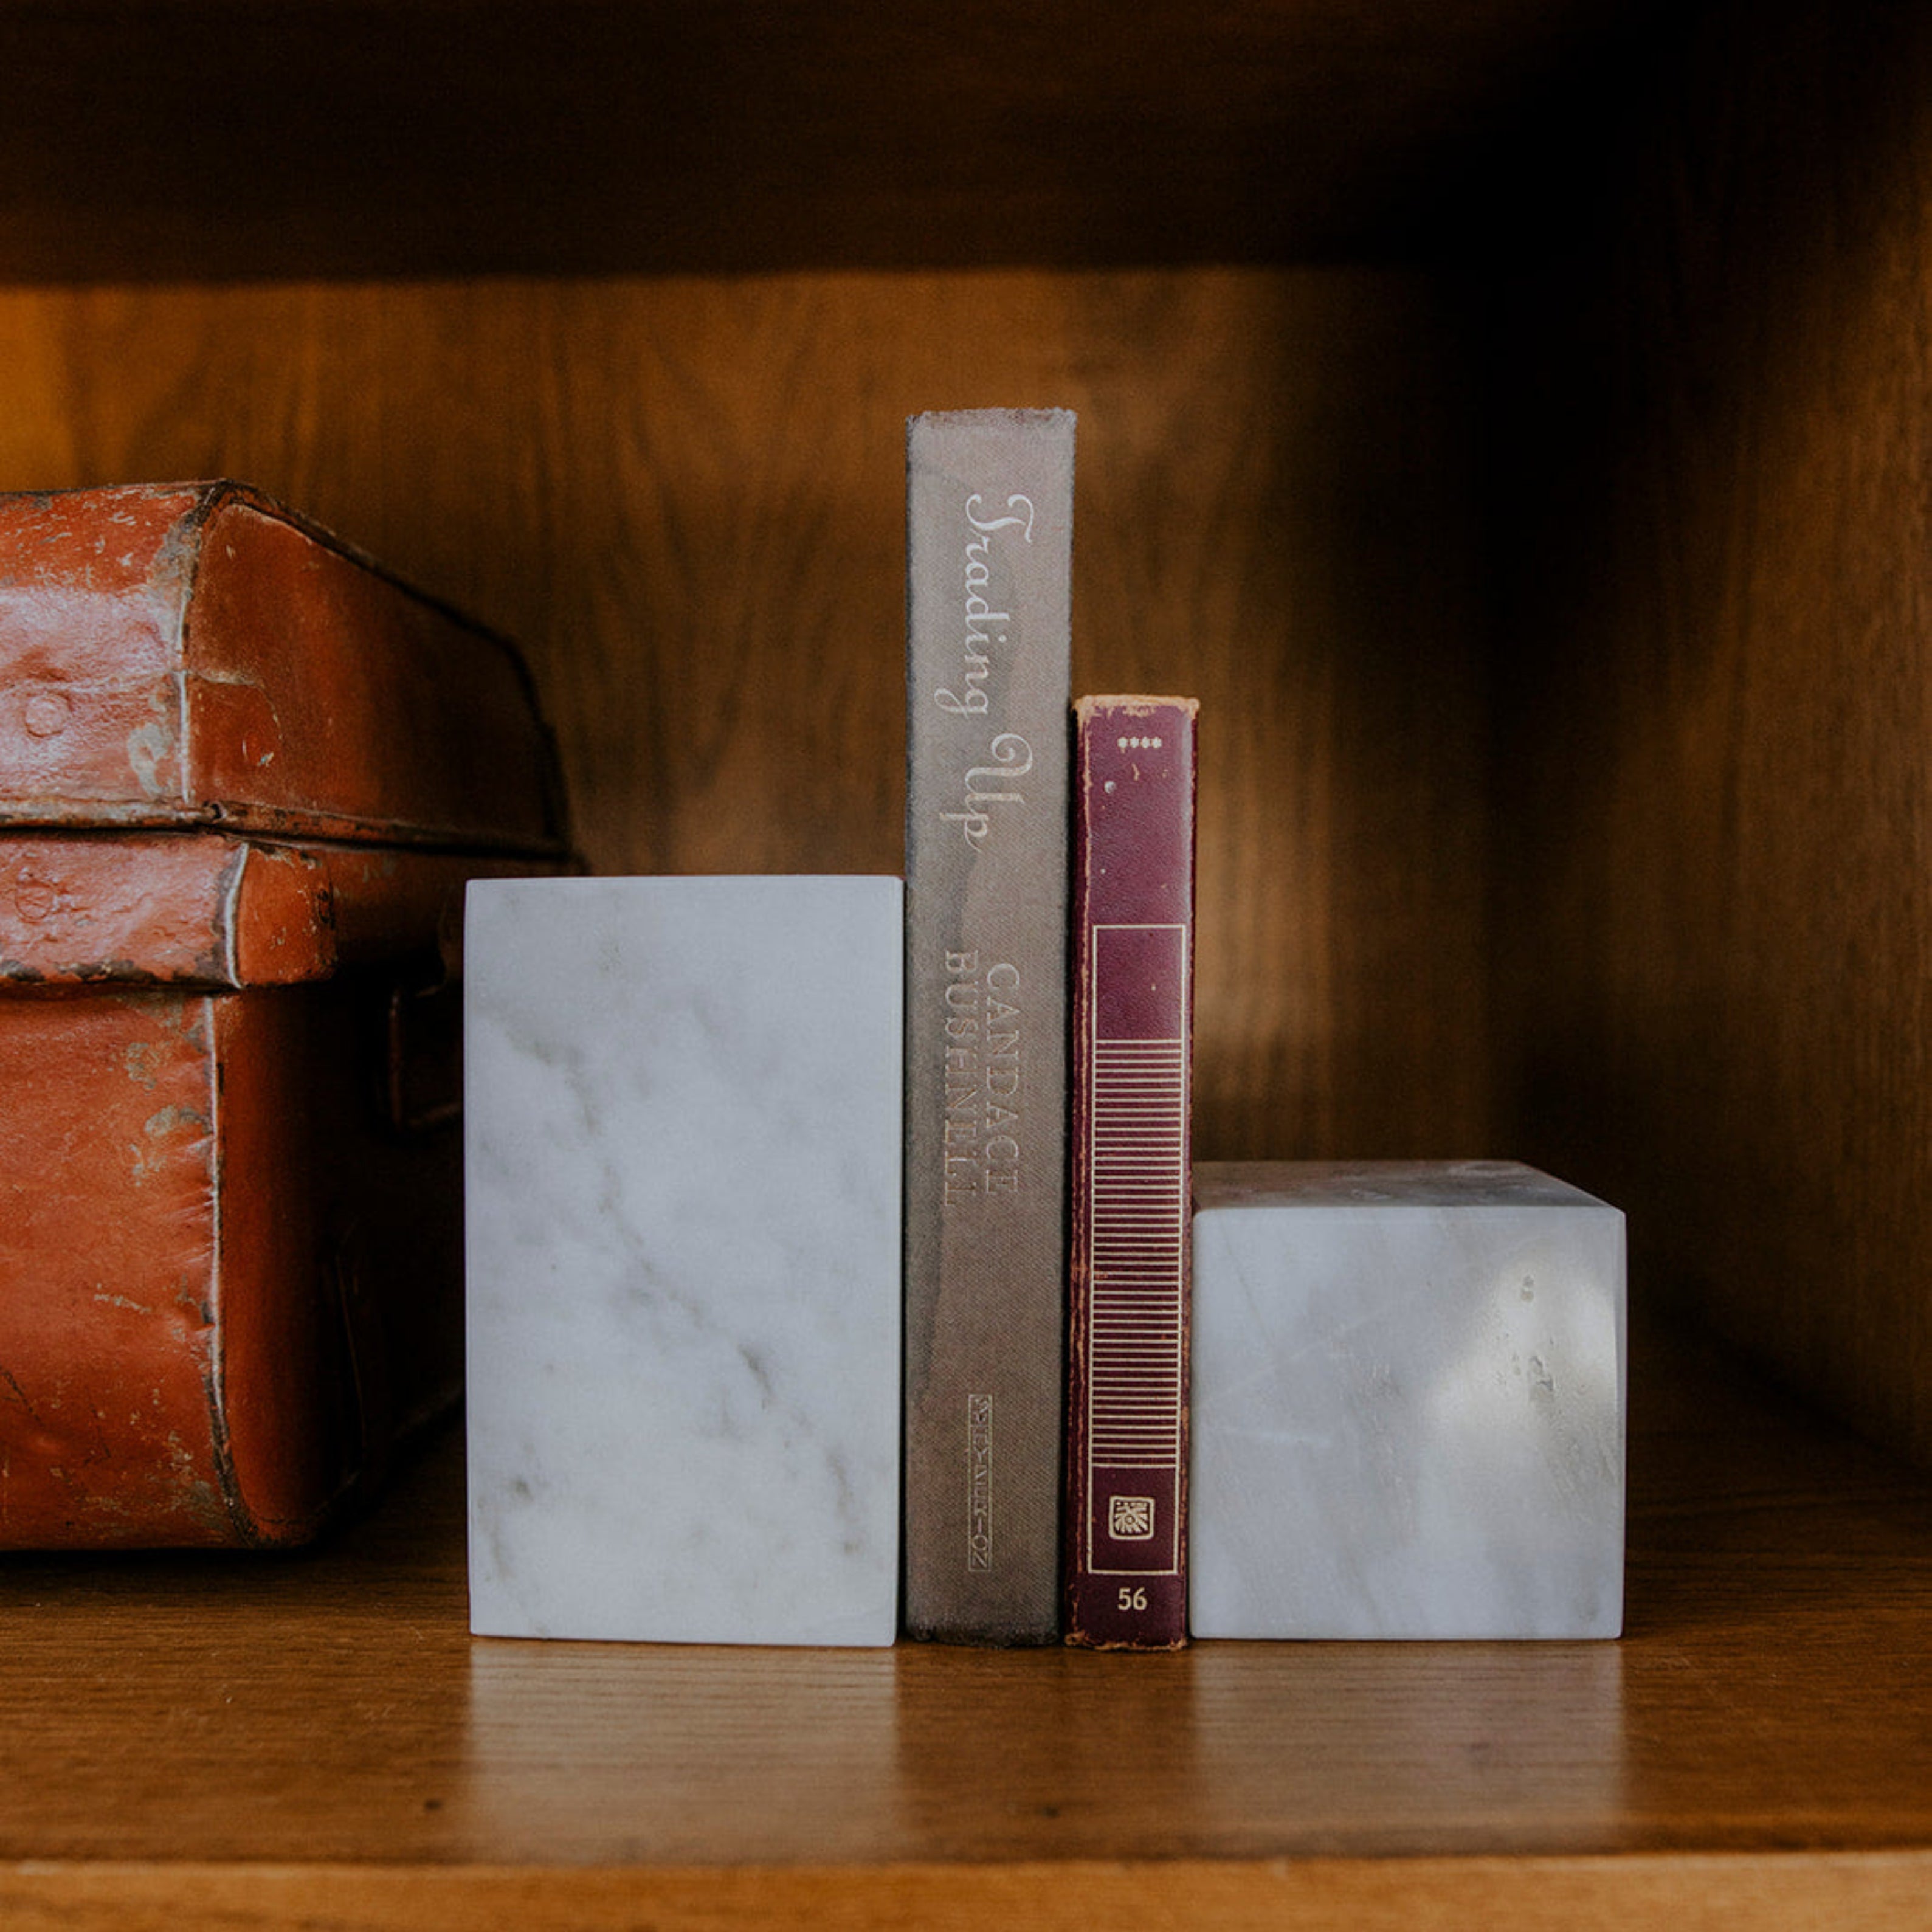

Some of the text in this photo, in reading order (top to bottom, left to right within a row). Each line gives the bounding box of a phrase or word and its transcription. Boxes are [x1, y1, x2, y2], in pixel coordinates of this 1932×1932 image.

[934, 494, 1033, 851] Trading Up
[945, 950, 978, 1207] BUSHNELL
[987, 962, 1020, 1195] CANDACE
[1117, 1587, 1148, 1611] 56
